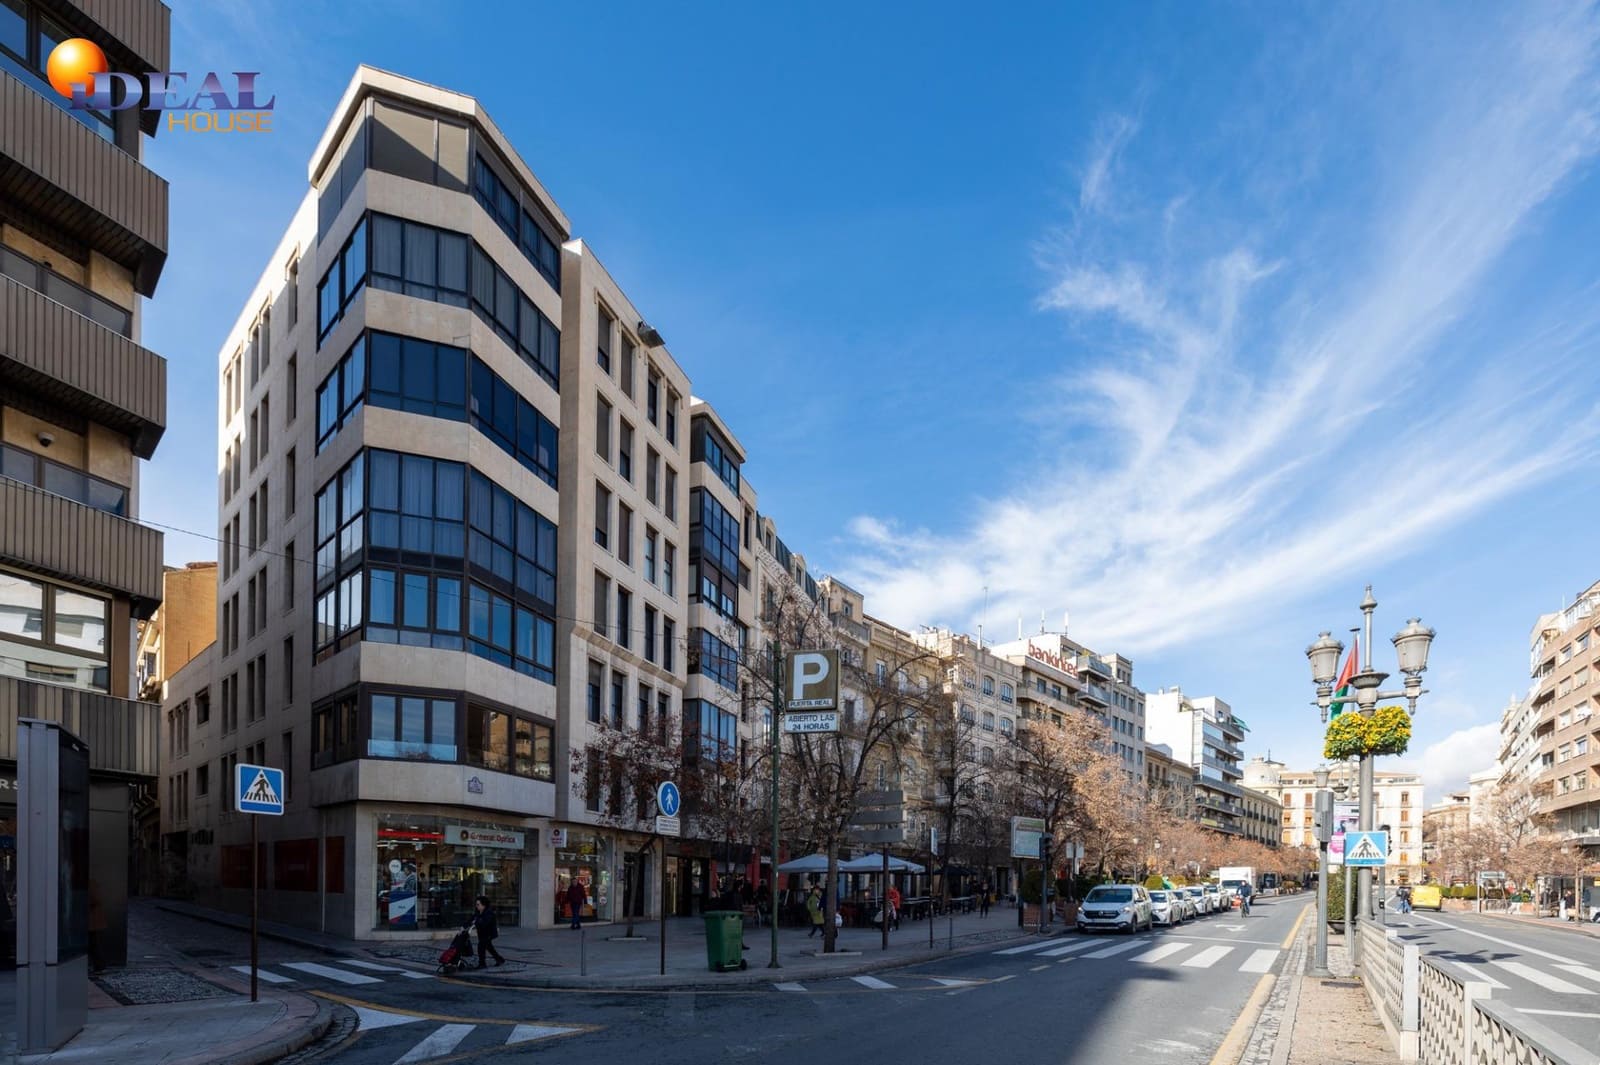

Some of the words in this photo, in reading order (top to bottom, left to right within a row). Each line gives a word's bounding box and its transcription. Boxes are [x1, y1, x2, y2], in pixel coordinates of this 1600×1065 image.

[793, 653, 830, 700] P
[788, 714, 818, 722] ABIERTO
[820, 713, 835, 721] LAS
[792, 723, 801, 731] 24
[803, 722, 830, 730] HORAS
